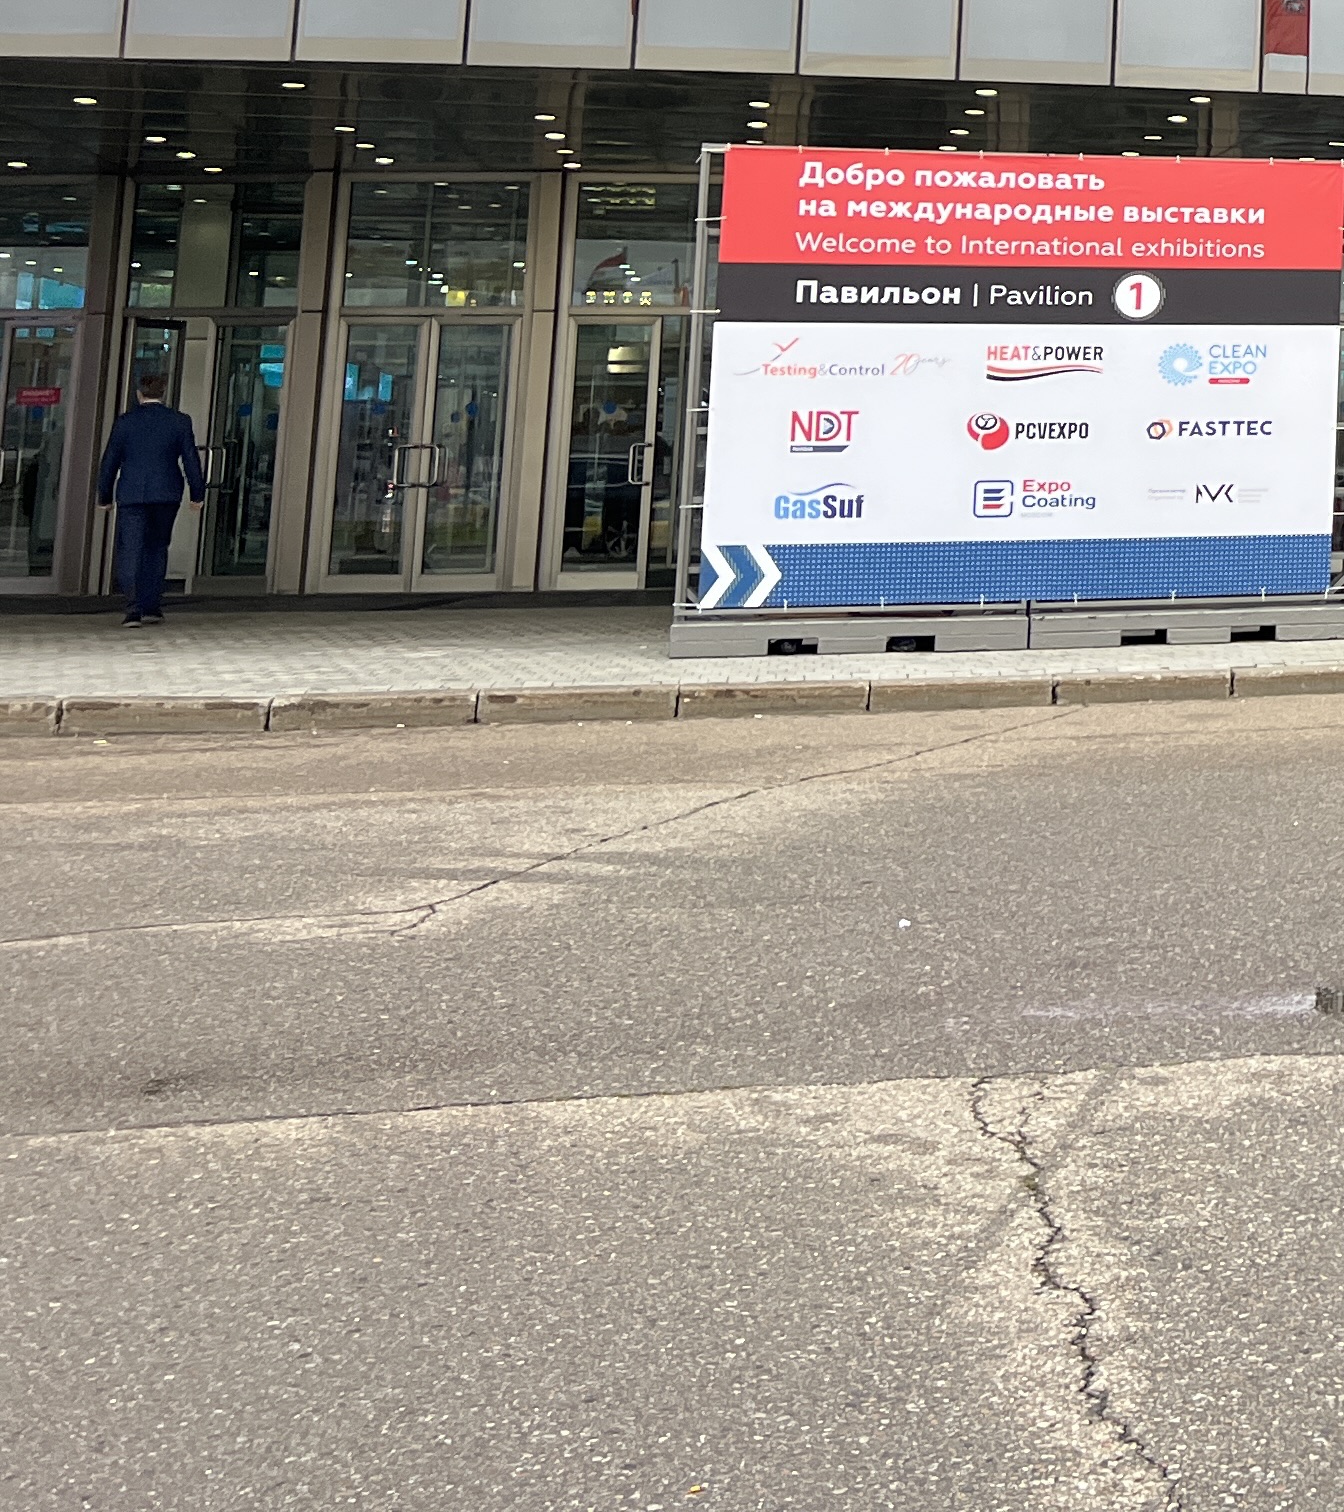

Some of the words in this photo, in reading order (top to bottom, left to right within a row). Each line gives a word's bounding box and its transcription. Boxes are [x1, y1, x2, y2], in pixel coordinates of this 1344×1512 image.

[798, 161, 905, 191] Добро
[914, 169, 1105, 191] пожаловать
[798, 198, 837, 217] на
[847, 199, 1114, 226] международные
[1123, 206, 1265, 225] выставки
[795, 231, 916, 254] Welcome
[926, 235, 952, 255] to
[960, 234, 1123, 257] International
[1131, 238, 1265, 258] exhibitions
[795, 279, 961, 305] Павильон
[989, 284, 1093, 306] Pavilion
[1129, 282, 1142, 311] 1
[986, 345, 1104, 361] HEAT&POWER
[1208, 344, 1267, 359] CLEAN
[761, 363, 885, 379] Testing&Control
[1208, 360, 1257, 375] EXPO
[790, 410, 860, 442] NDT
[1014, 422, 1090, 440] PCVEXPO
[1022, 479, 1072, 494] Expo
[774, 494, 865, 520] GasSuf
[1021, 494, 1096, 510] Coating
